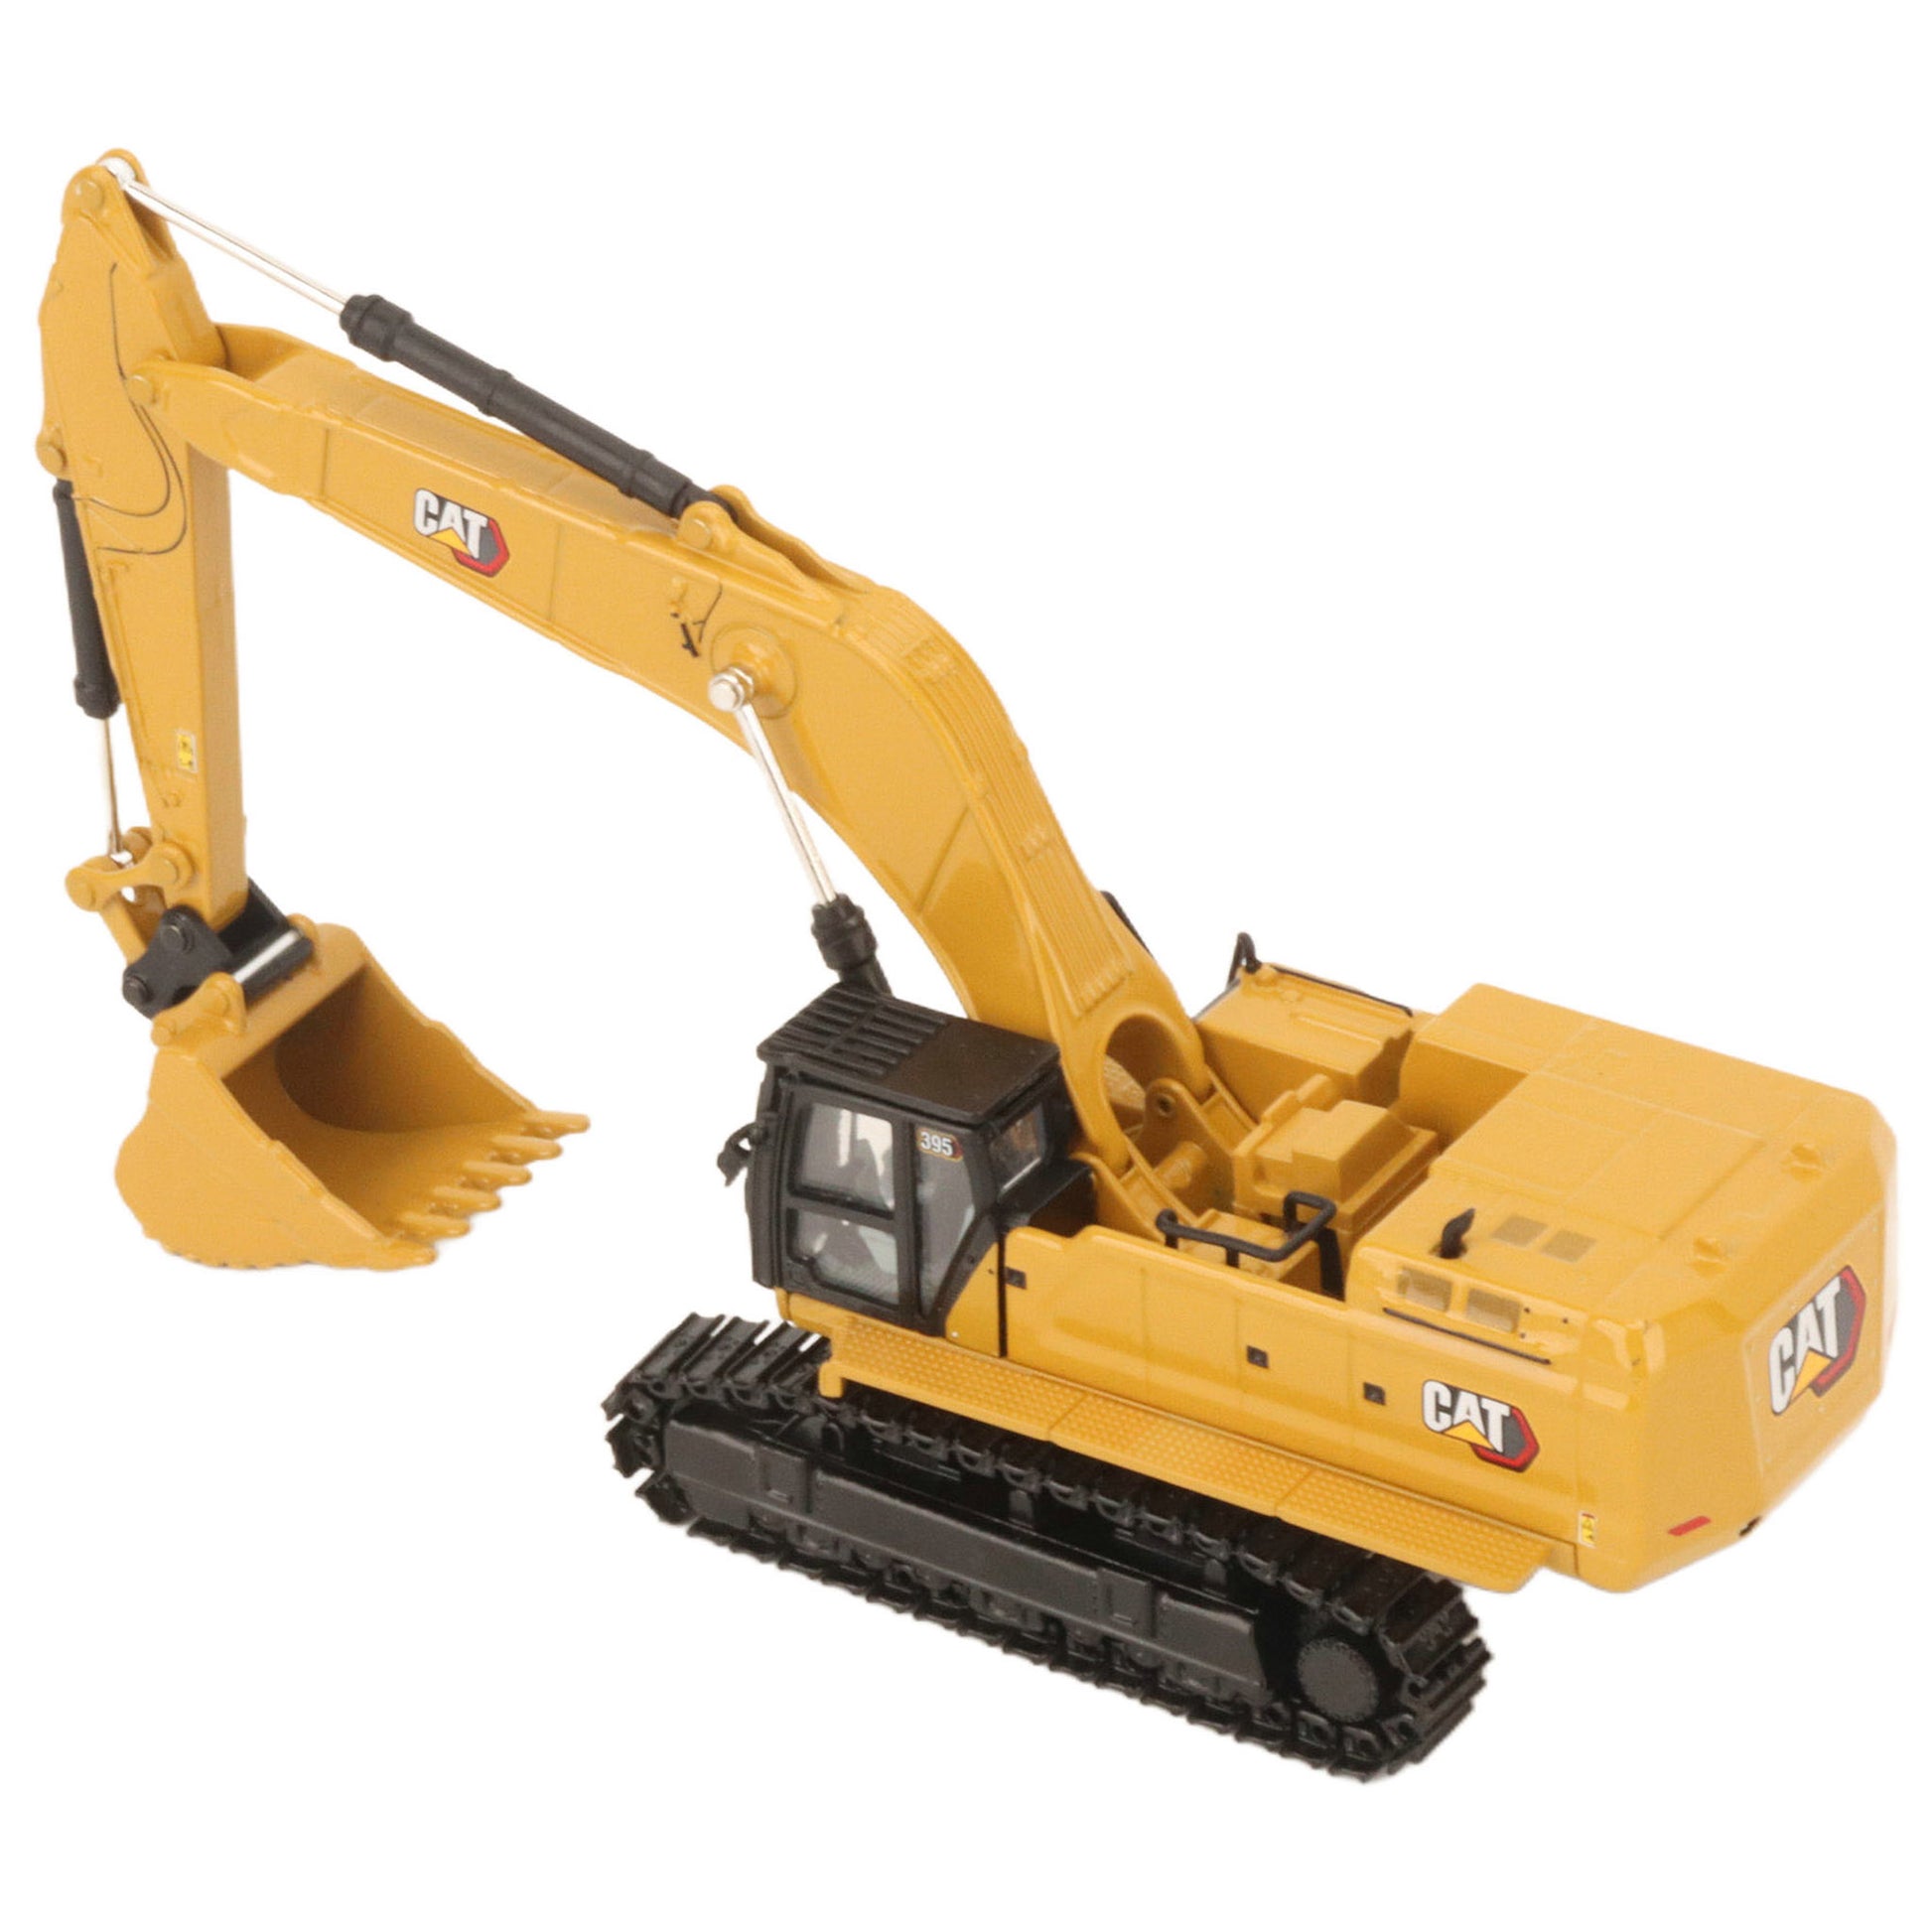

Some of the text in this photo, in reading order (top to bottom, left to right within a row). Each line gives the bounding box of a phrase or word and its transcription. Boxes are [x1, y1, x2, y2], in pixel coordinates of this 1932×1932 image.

[414, 488, 489, 559] CAT
[920, 1131, 953, 1157] 395
[1769, 1276, 1841, 1414] CAT
[1422, 1379, 1511, 1453] CAT
